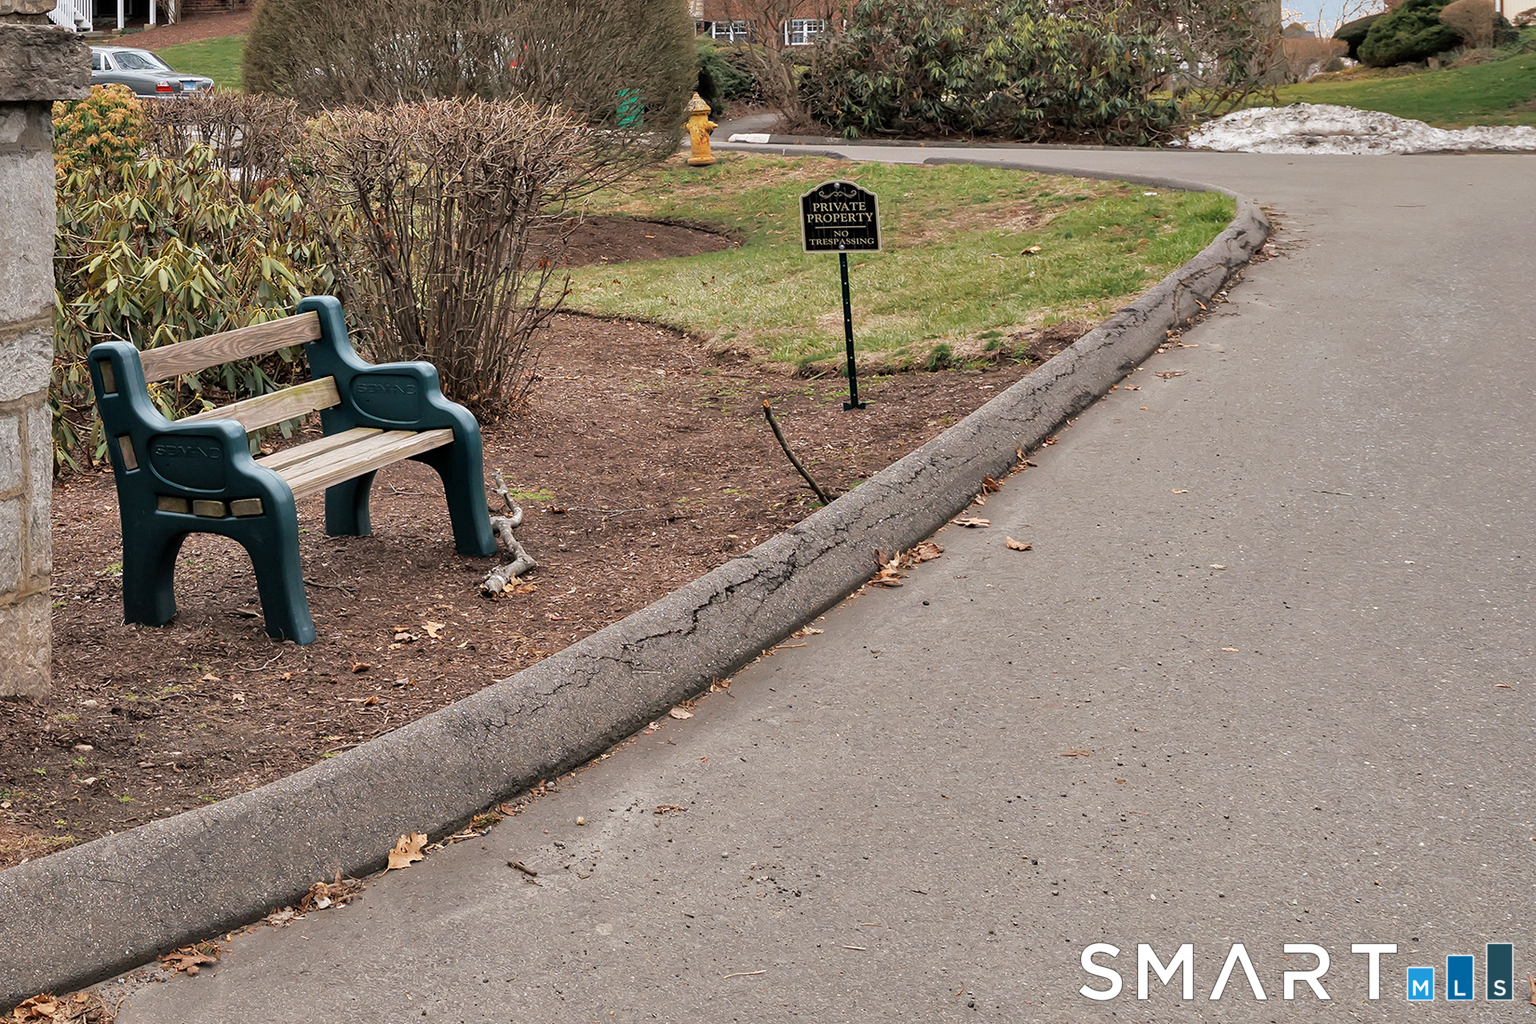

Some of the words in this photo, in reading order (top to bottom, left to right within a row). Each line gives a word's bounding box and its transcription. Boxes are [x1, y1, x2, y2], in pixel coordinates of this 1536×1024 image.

[812, 202, 867, 212] PRIVATE
[806, 212, 874, 224] PROPERTY
[808, 237, 875, 246] TRESPASSING
